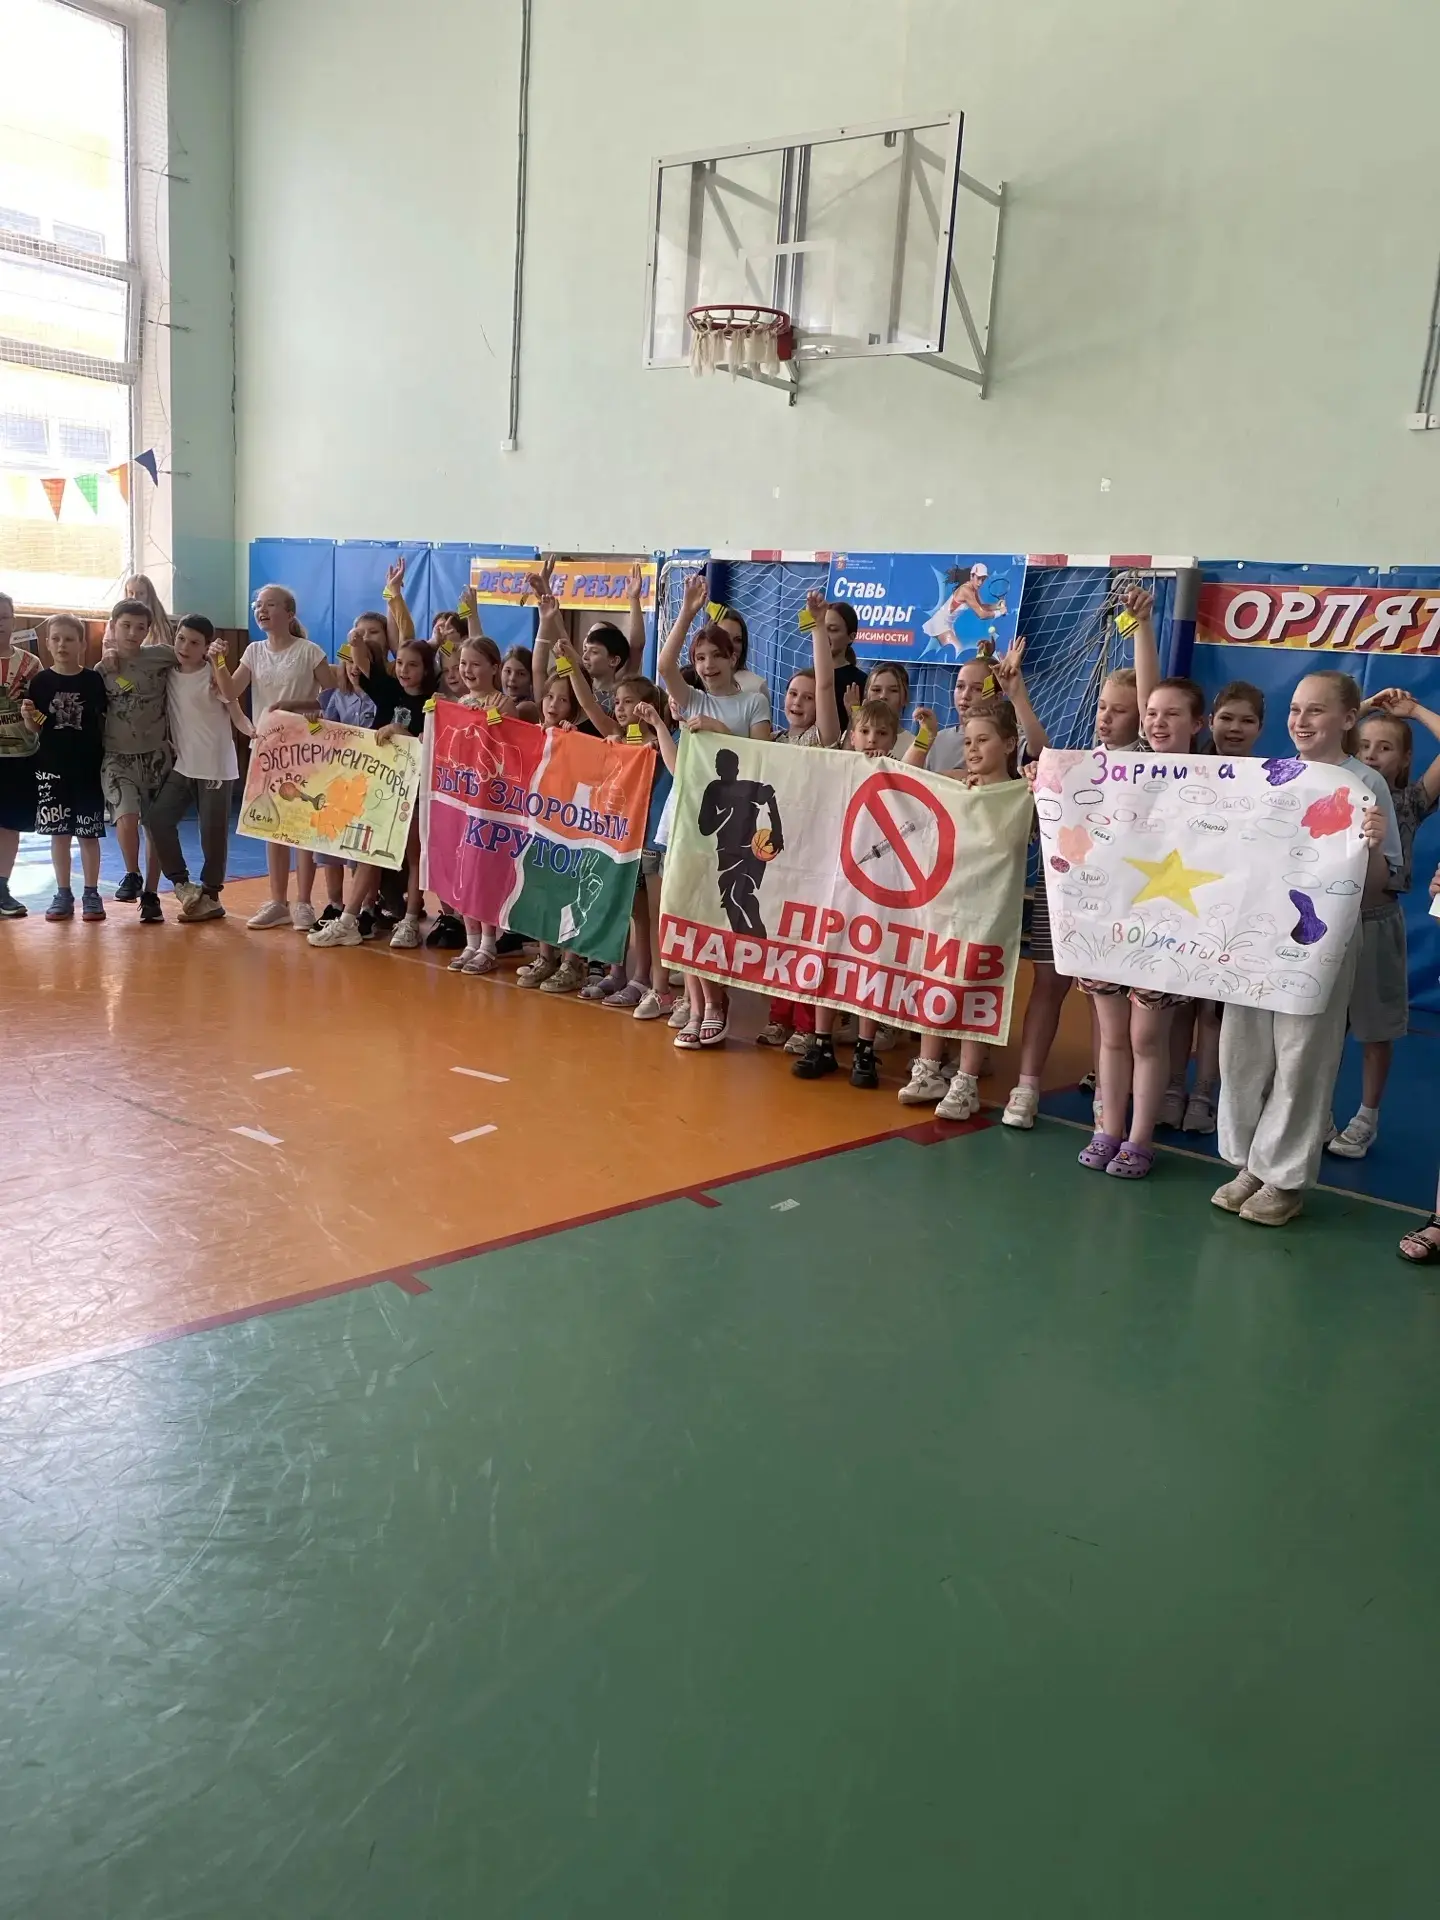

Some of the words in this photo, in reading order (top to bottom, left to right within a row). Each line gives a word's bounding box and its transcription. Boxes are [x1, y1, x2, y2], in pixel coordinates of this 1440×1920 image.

[572, 574, 651, 599] РЕБЯА
[833, 576, 886, 599] Ставь
[853, 604, 911, 627] корды
[465, 814, 583, 879] КРУТО!
[777, 900, 1005, 981] ПРОТИВ
[661, 920, 999, 1028] НАРКОТИКОВ
